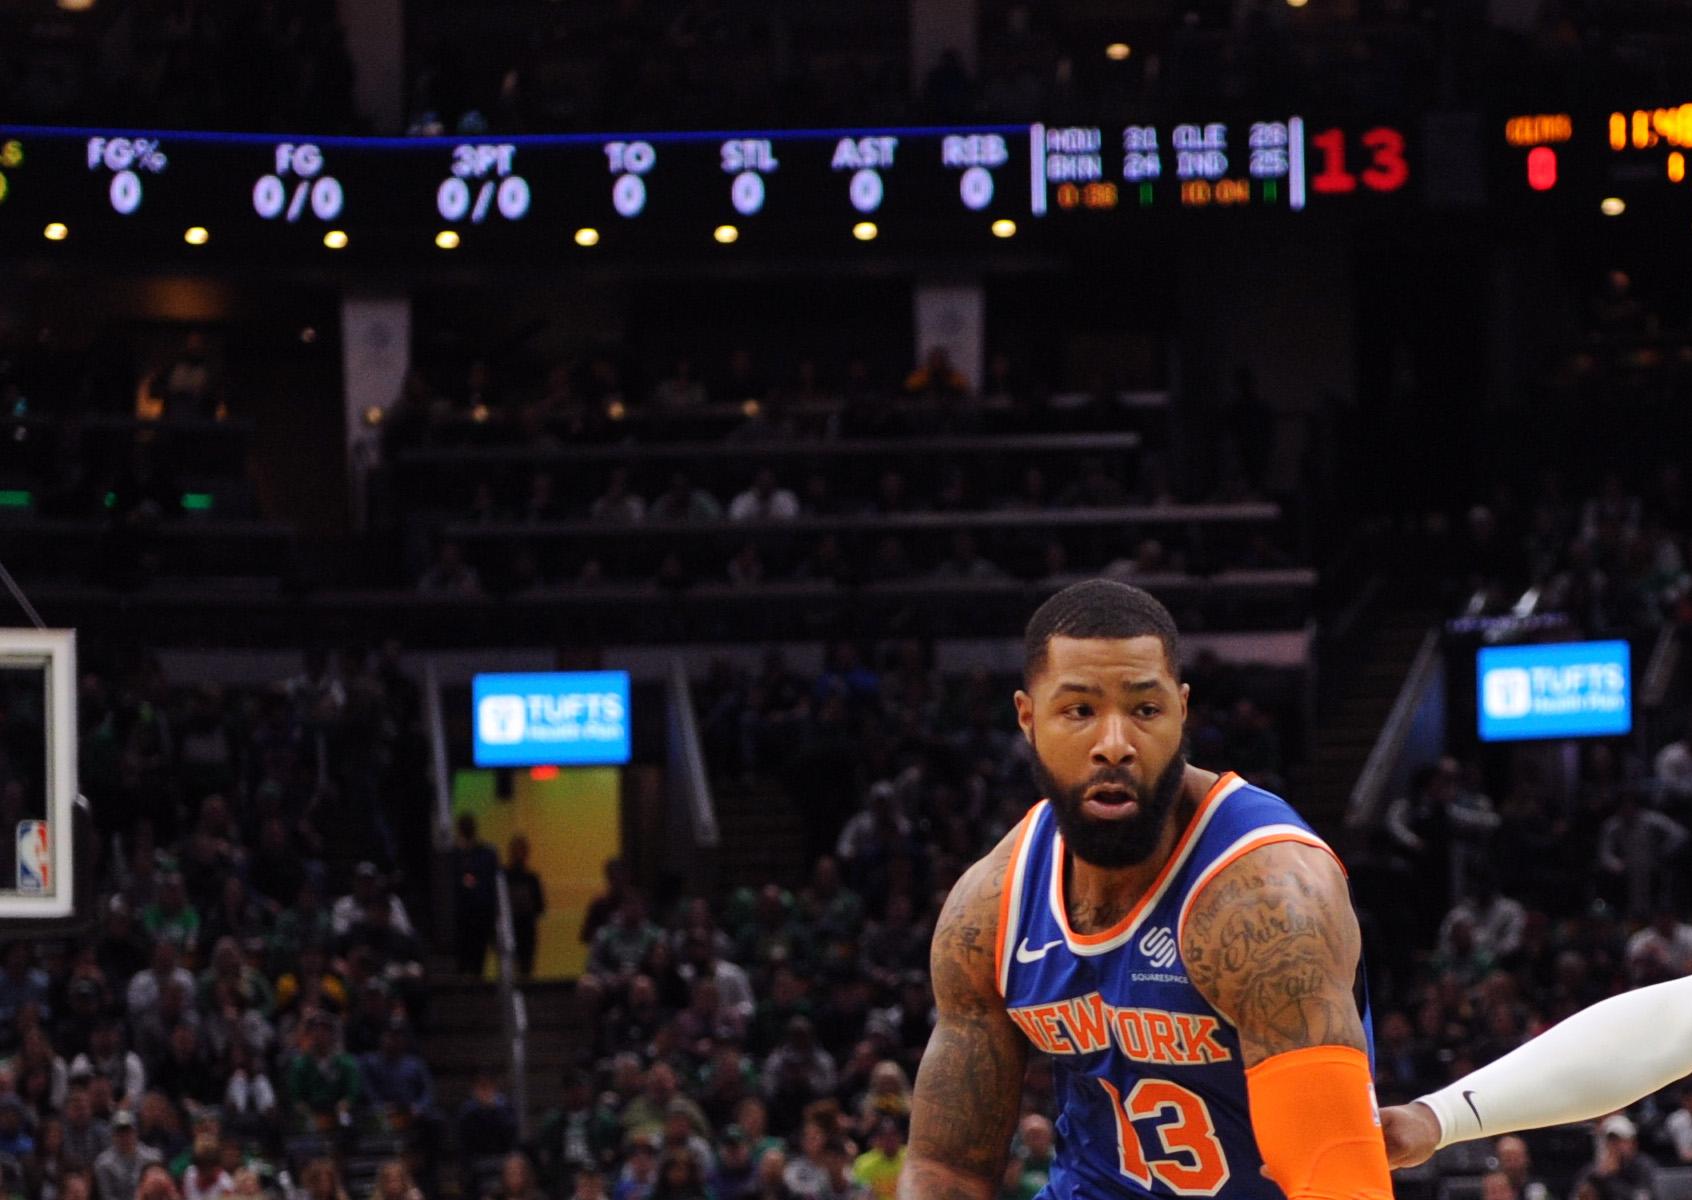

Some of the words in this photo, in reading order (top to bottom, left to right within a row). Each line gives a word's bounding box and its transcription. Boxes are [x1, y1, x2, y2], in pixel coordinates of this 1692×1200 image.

[87, 137, 168, 173] FG%
[276, 143, 323, 176] FG
[451, 144, 515, 177] 3PT
[604, 141, 656, 175] TO
[720, 139, 779, 172] STL
[831, 136, 898, 170] AST
[942, 134, 1008, 168] REB
[1311, 127, 1409, 192] 13
[110, 170, 141, 214] 0
[253, 173, 343, 222] 0/0
[437, 176, 531, 224] 0/0
[612, 173, 646, 217] 0
[731, 170, 765, 215] 0
[850, 168, 884, 212] 0
[960, 166, 994, 210] 0
[1531, 663, 1625, 693] TUFTS
[526, 692, 625, 723] TUFTS
[1131, 972, 1189, 984] SQUARESPACE
[1007, 992, 1111, 1056] NEW
[1098, 1078, 1231, 1197] 13
